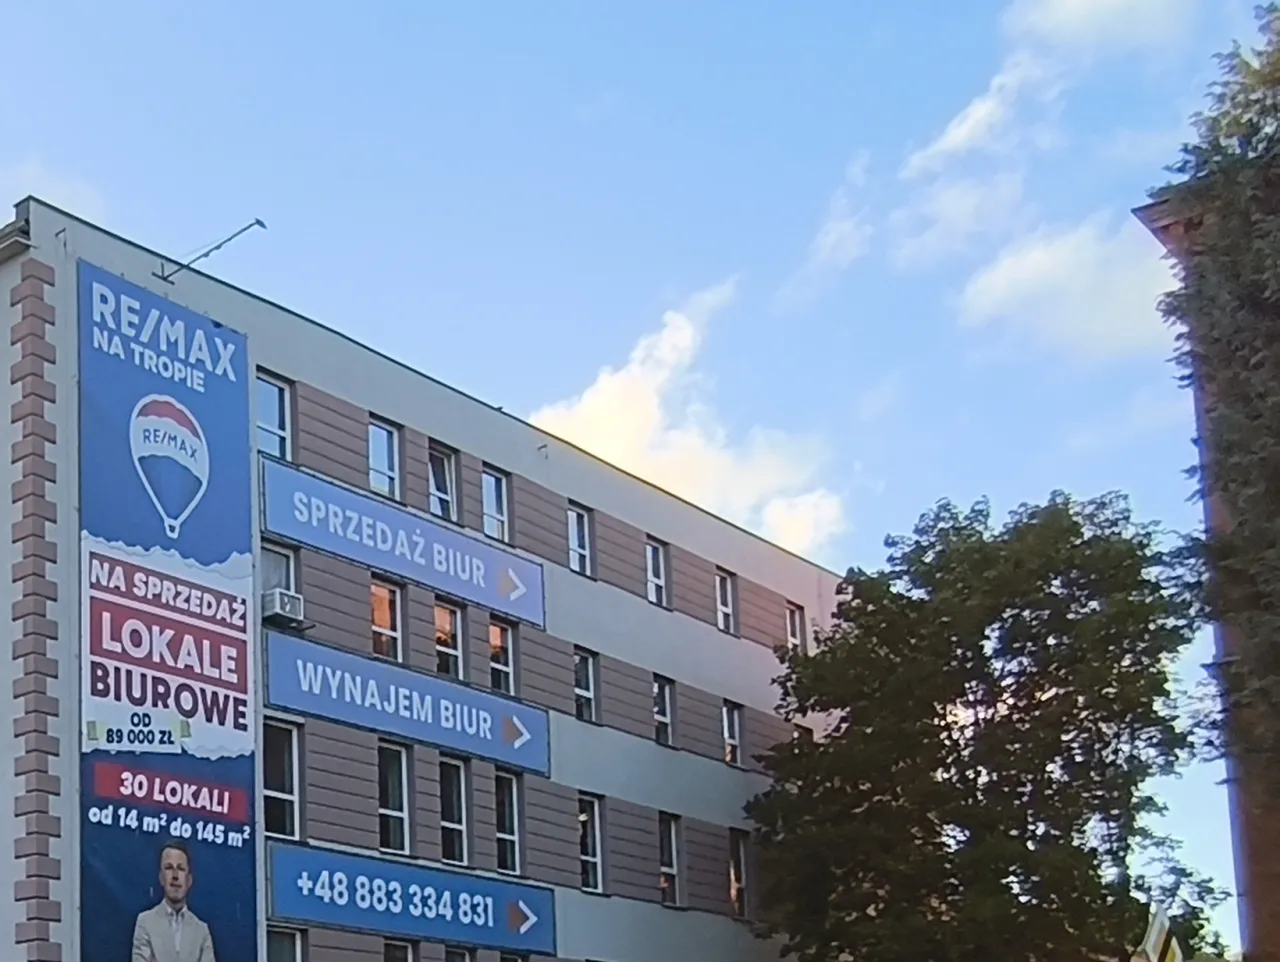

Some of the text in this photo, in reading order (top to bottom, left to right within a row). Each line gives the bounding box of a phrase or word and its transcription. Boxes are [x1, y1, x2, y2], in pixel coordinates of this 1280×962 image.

[92, 280, 237, 382] RE/MAX
[92, 326, 206, 393] NA TROPIE
[142, 428, 198, 464] RE/MAX
[293, 491, 487, 588] SPRZEDAŻ BIUR
[90, 559, 245, 627] NA SPRZEDAŻ
[101, 611, 238, 684] LOKALE
[90, 660, 248, 732] BIUROWE
[130, 712, 152, 728] OD
[296, 658, 493, 741] WYNAJEM BIUR
[127, 729, 156, 744] 000
[88, 805, 113, 825] od
[117, 809, 138, 829] 14
[169, 817, 192, 838] do
[196, 821, 225, 845] 145
[119, 771, 230, 815] 30 LOKALI
[297, 870, 494, 927] +48 883 334 831
